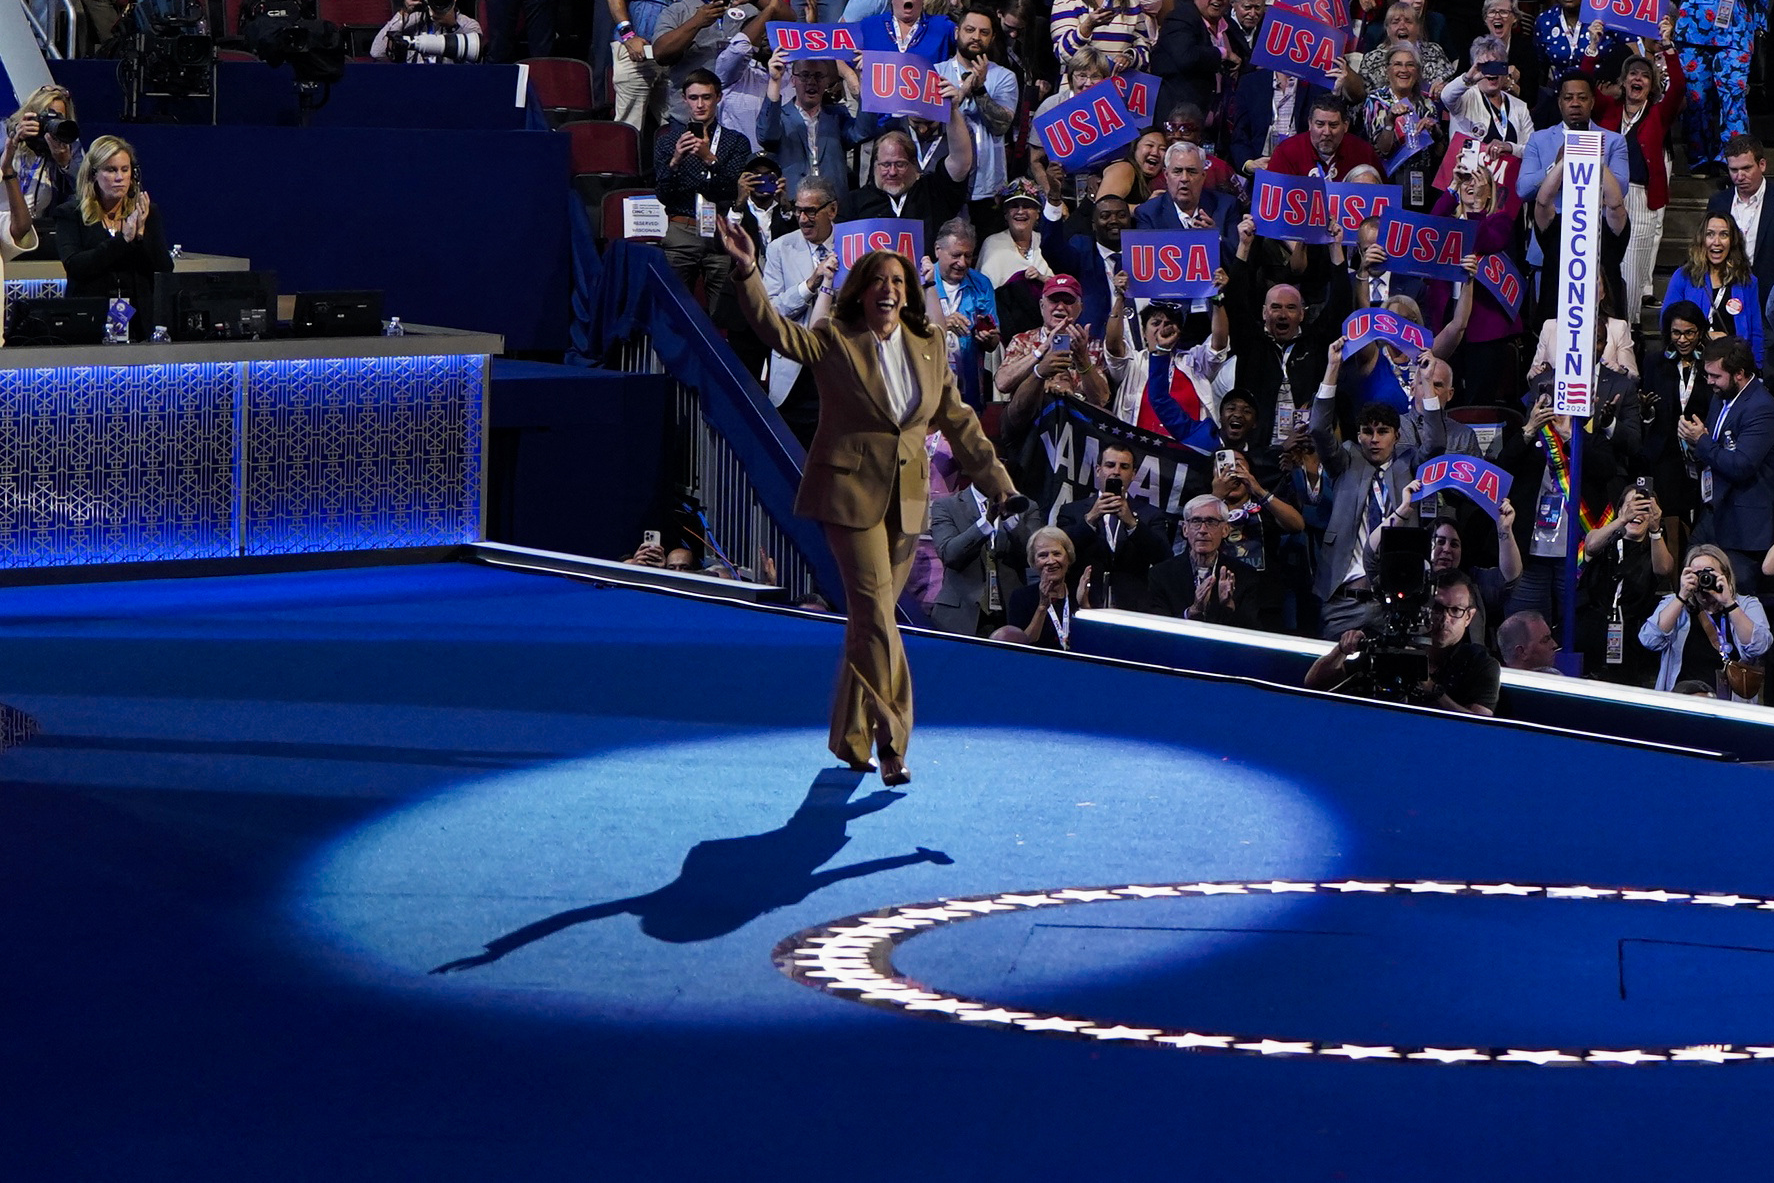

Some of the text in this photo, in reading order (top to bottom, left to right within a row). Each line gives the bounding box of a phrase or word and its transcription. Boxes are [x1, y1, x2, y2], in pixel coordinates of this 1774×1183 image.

[1266, 21, 1335, 75] USA
[872, 63, 947, 105] USA
[1046, 97, 1124, 157] USA
[1131, 245, 1211, 283] USA
[1386, 221, 1462, 265] USA
[1564, 160, 1592, 376] WISCONSIN
[1422, 460, 1500, 502] USA
